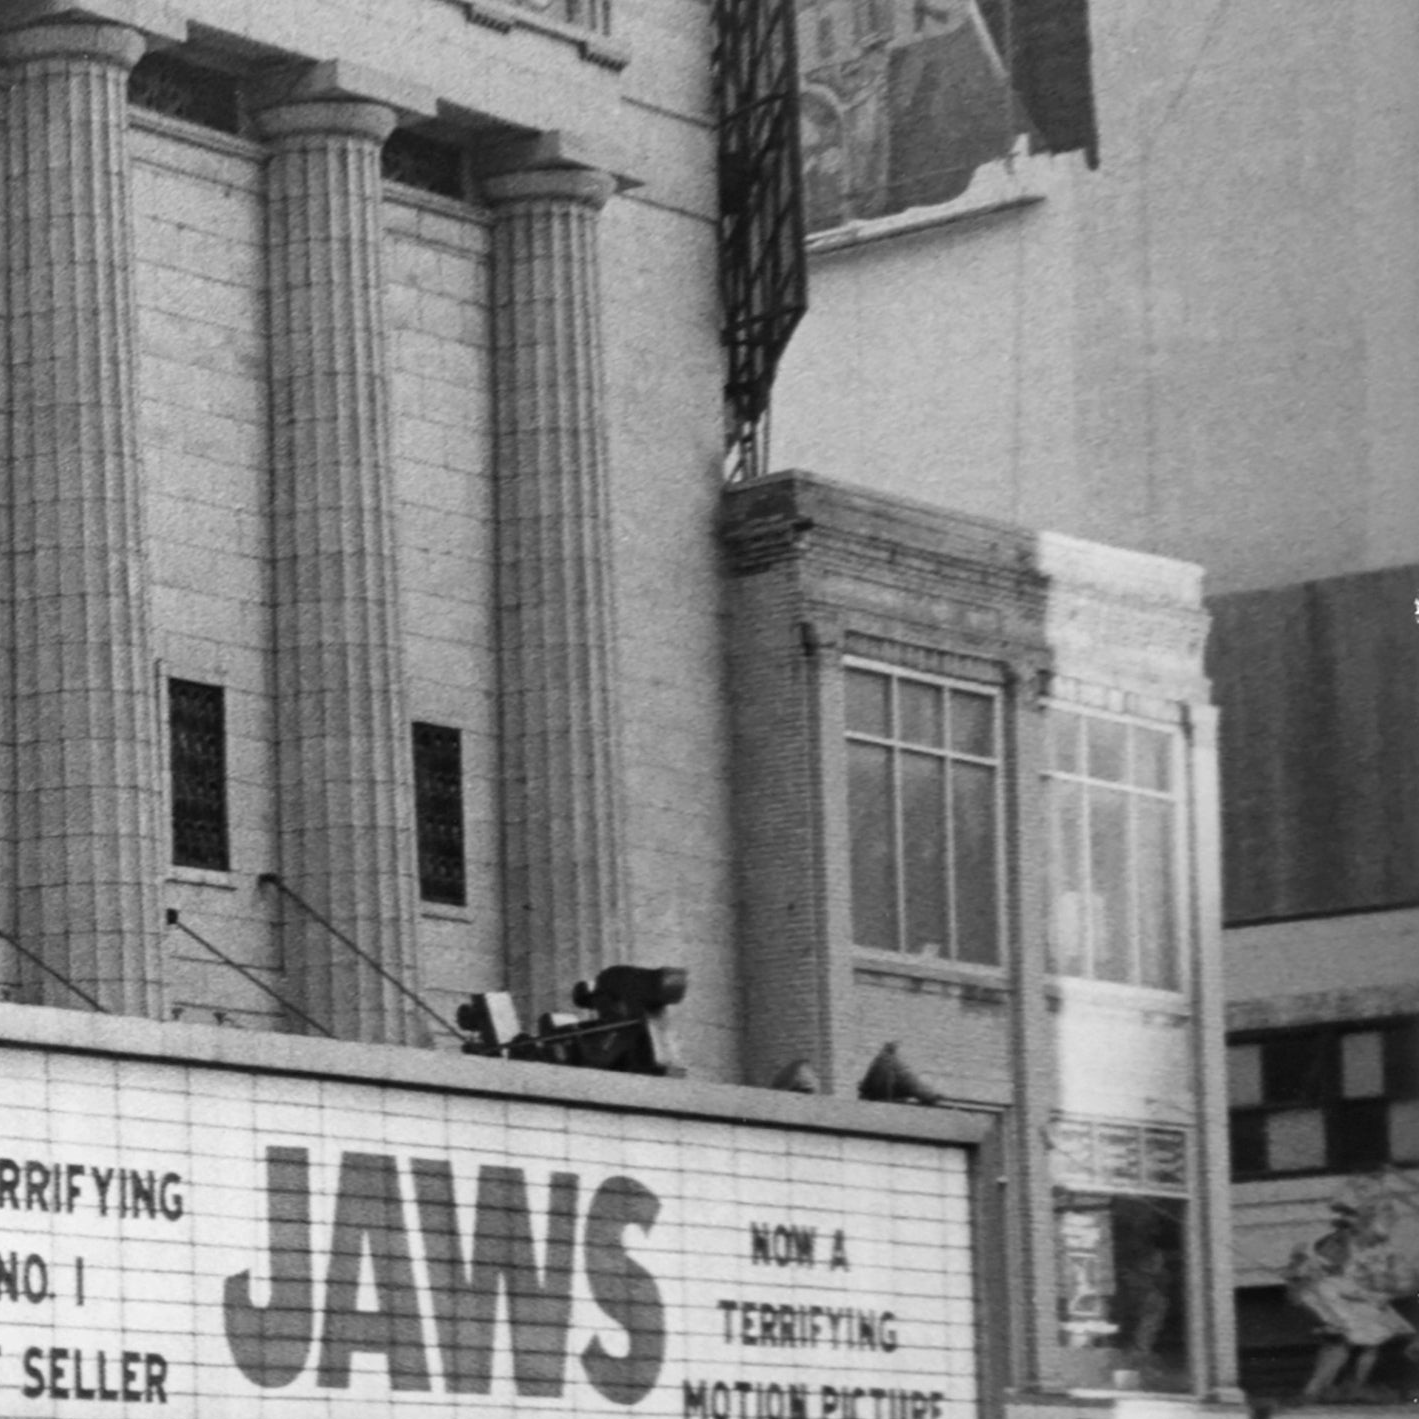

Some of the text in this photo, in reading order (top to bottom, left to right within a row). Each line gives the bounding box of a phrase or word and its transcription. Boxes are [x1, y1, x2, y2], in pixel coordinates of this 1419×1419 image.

[222, 1144, 667, 1406] JAWS
[750, 1221, 850, 1273] NOW A
[717, 1298, 898, 1354] TERRIFYING
[22, 1346, 169, 1405] SELLER
